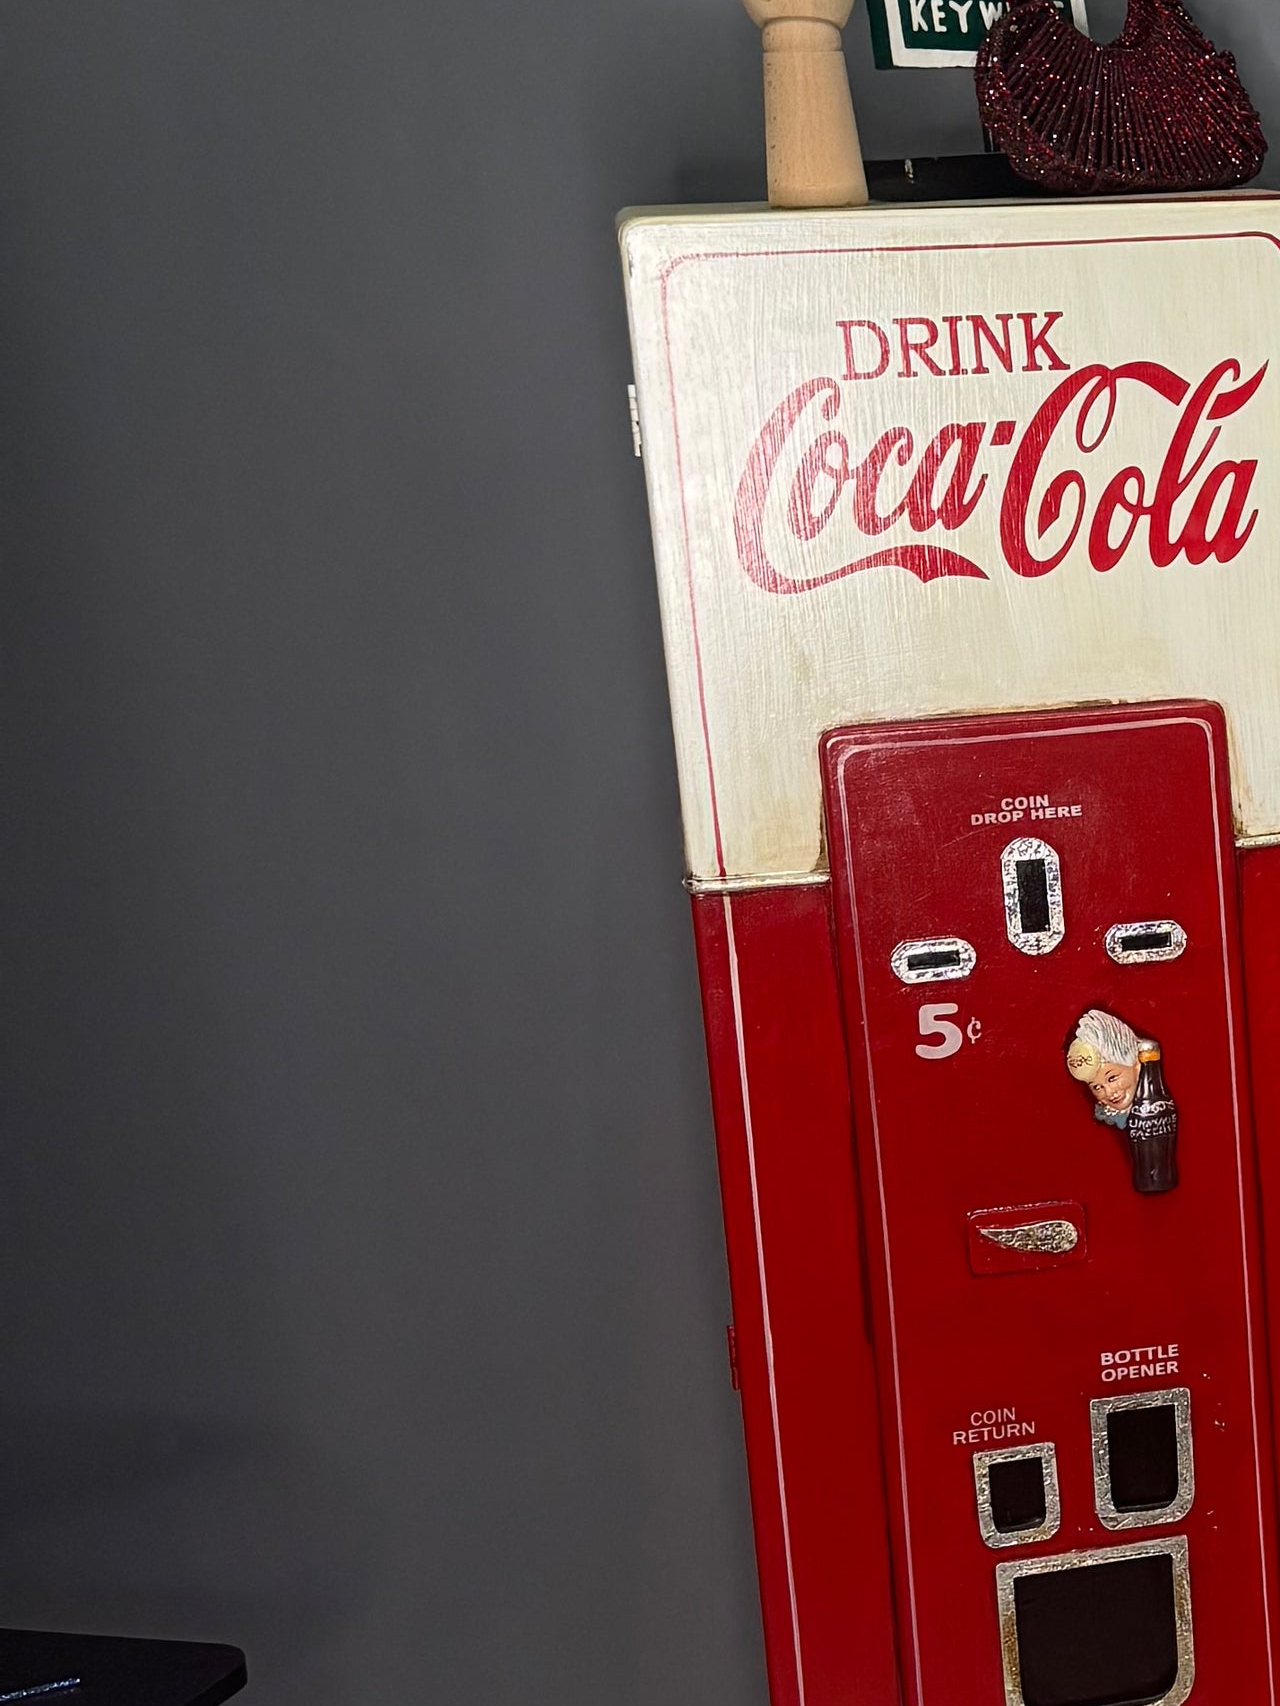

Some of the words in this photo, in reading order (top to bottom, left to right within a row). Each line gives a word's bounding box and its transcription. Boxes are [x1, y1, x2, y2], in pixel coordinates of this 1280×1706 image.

[836, 310, 1071, 381] DRINK
[733, 358, 1270, 595] Coca-Cola
[970, 808, 1026, 827] DROP
[1030, 803, 1083, 821] HERE
[1000, 794, 1050, 812] COIN
[1100, 1343, 1180, 1367] BOTTLE
[1100, 1360, 1180, 1383] OPENER
[969, 1405, 1017, 1427] COIN
[952, 1420, 1036, 1446] RETURN
